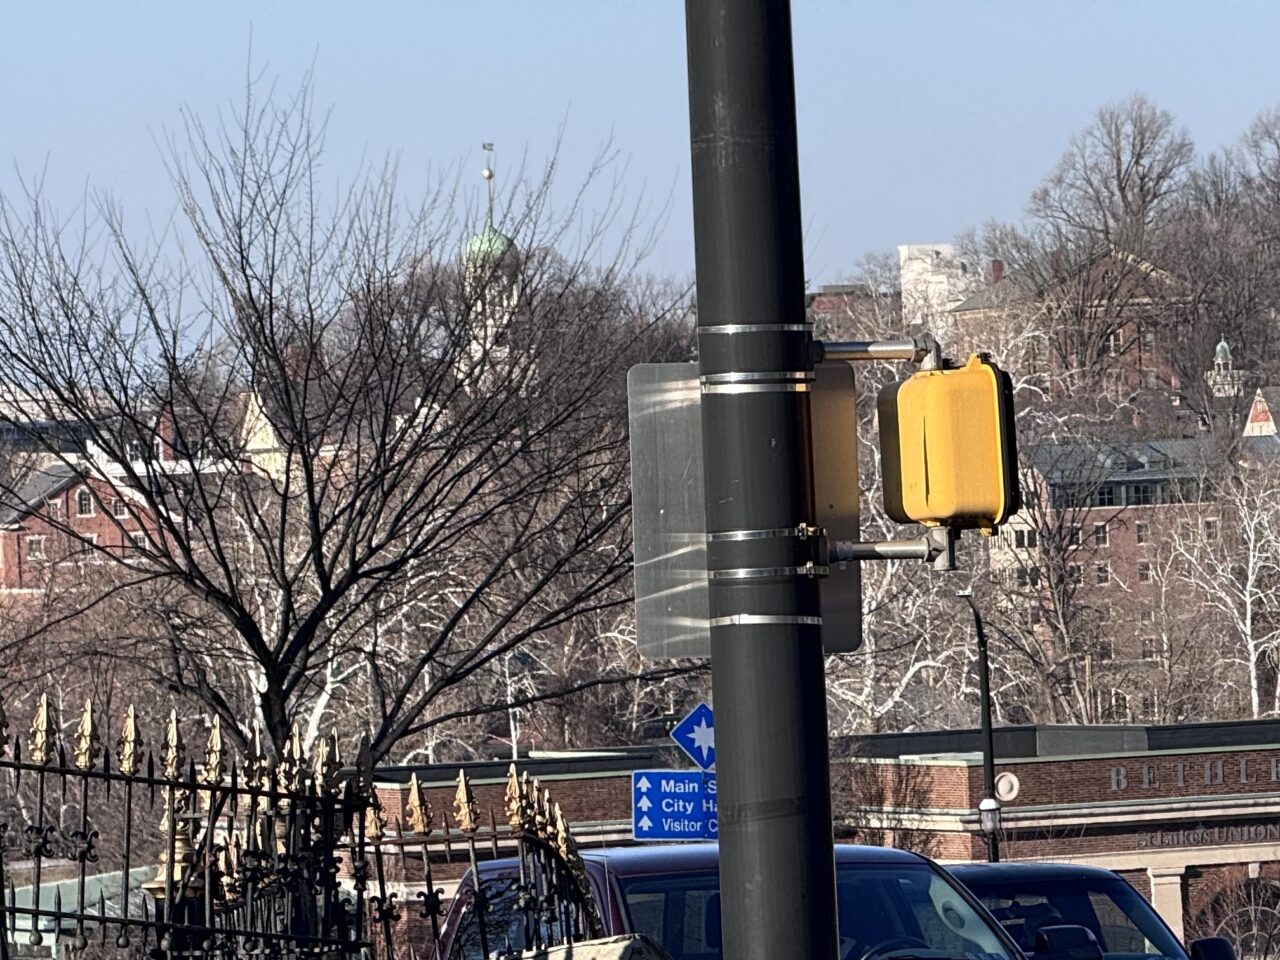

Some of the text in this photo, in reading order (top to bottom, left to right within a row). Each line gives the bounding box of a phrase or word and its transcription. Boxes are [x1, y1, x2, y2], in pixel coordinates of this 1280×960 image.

[661, 779, 699, 793] Main
[661, 798, 694, 815] City
[662, 818, 703, 832] Visitor
[1214, 823, 1280, 843] UNION
